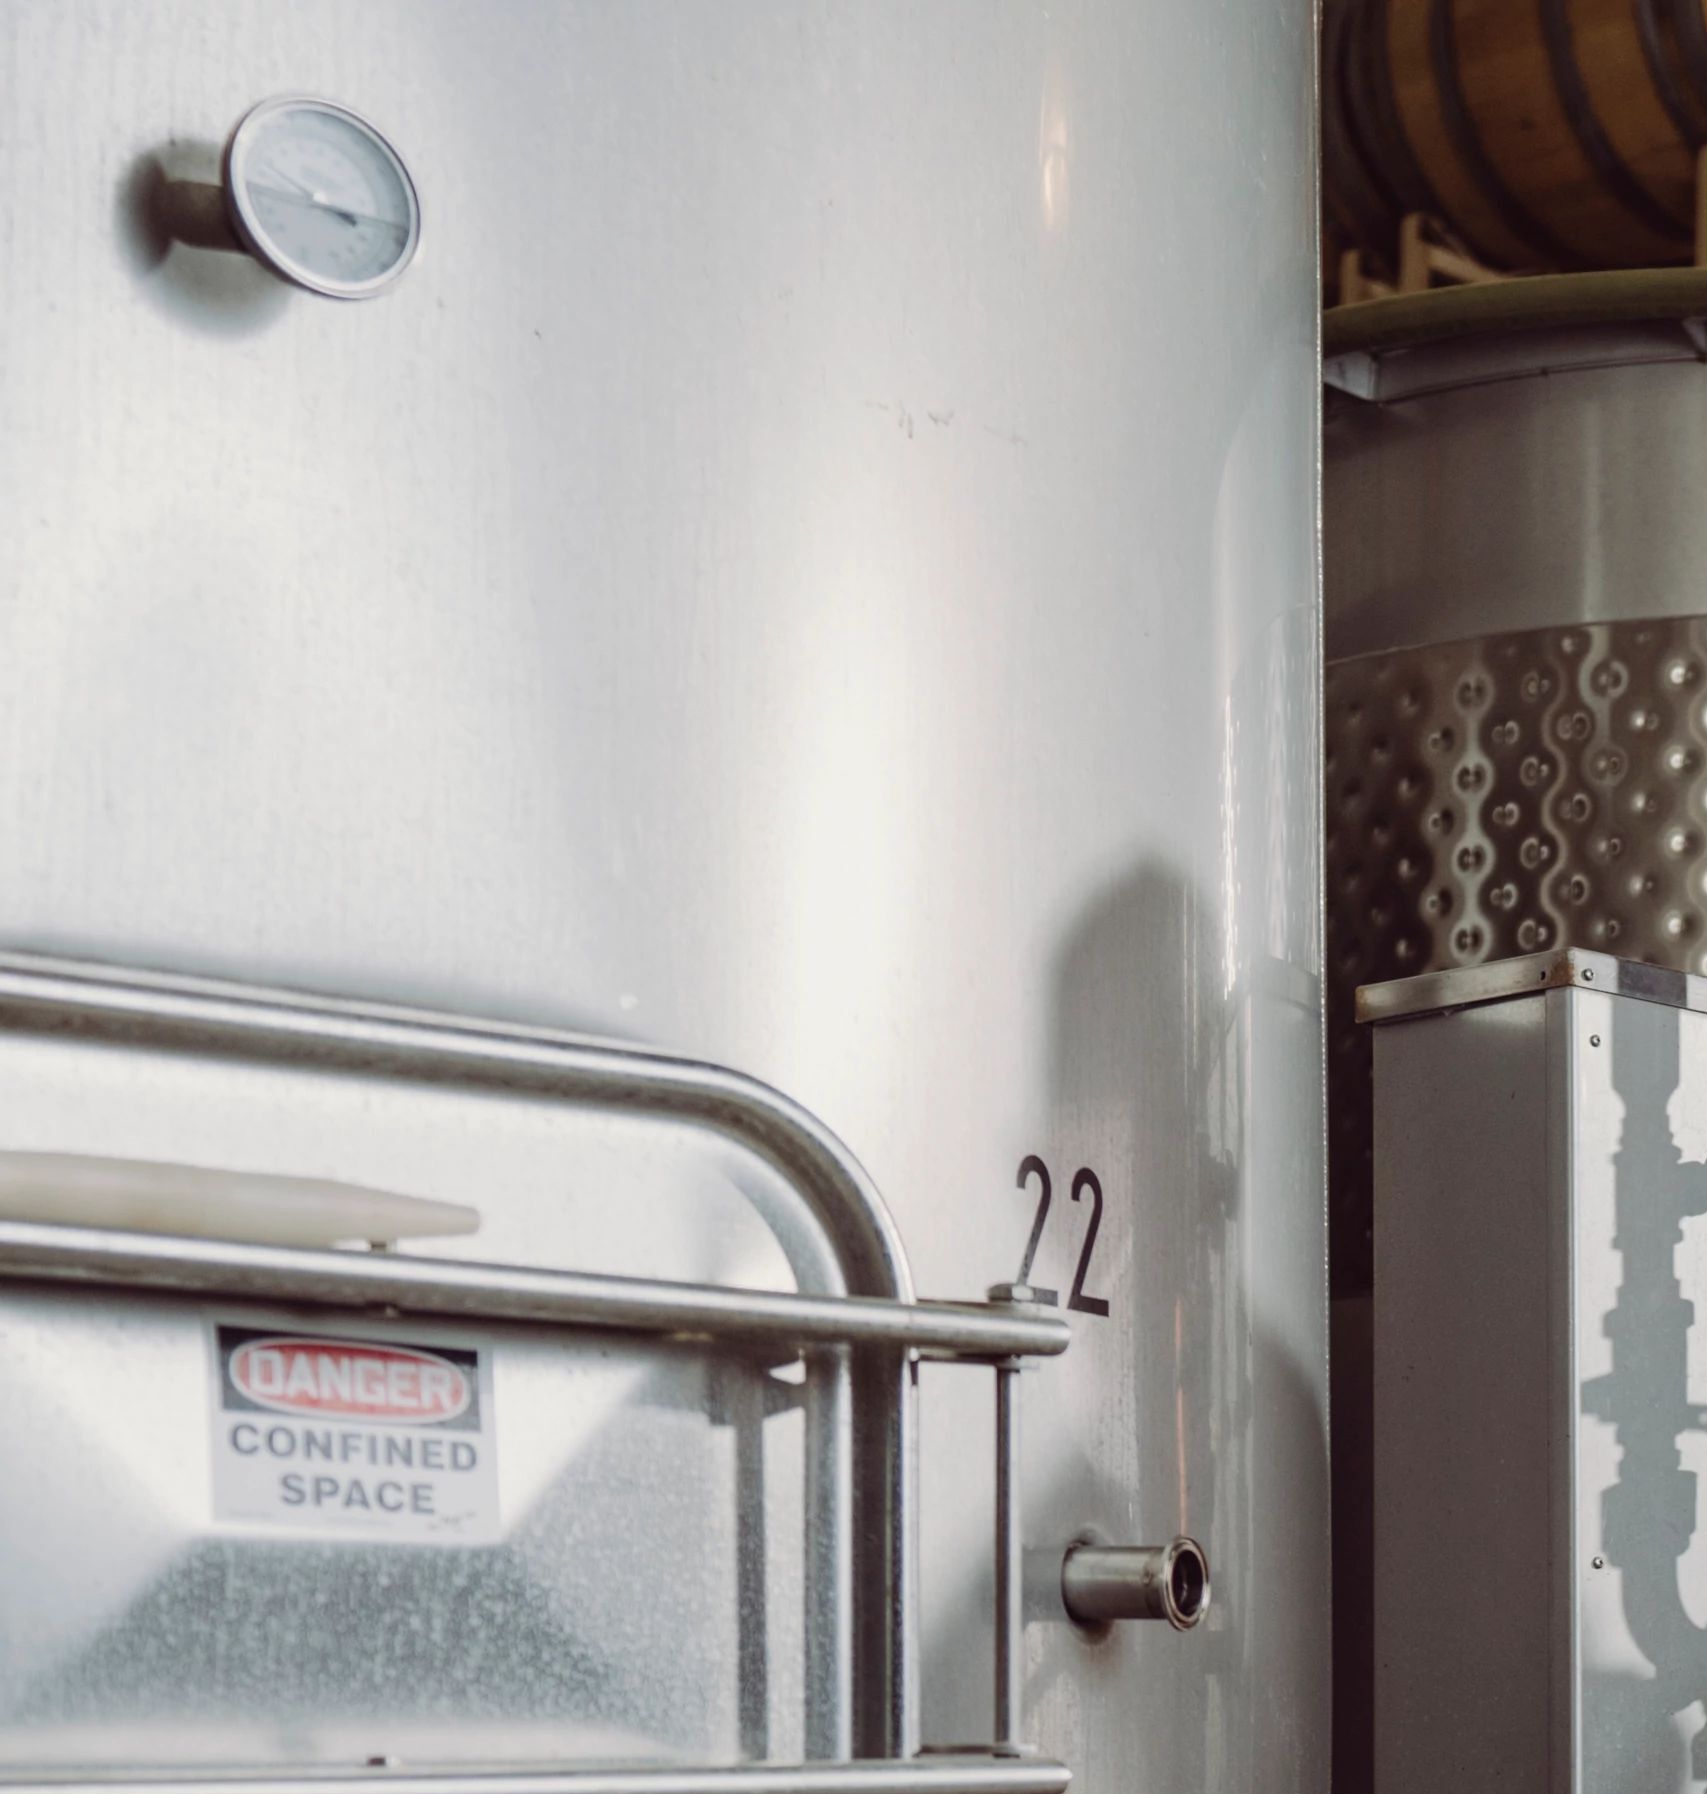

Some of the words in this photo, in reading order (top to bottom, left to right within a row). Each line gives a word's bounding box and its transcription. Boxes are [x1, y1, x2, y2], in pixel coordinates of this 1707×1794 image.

[1016, 1154, 1109, 1318] 22
[249, 1349, 453, 1410] DANGER
[230, 1422, 478, 1472] CONFINED
[280, 1472, 436, 1515] SPACE
